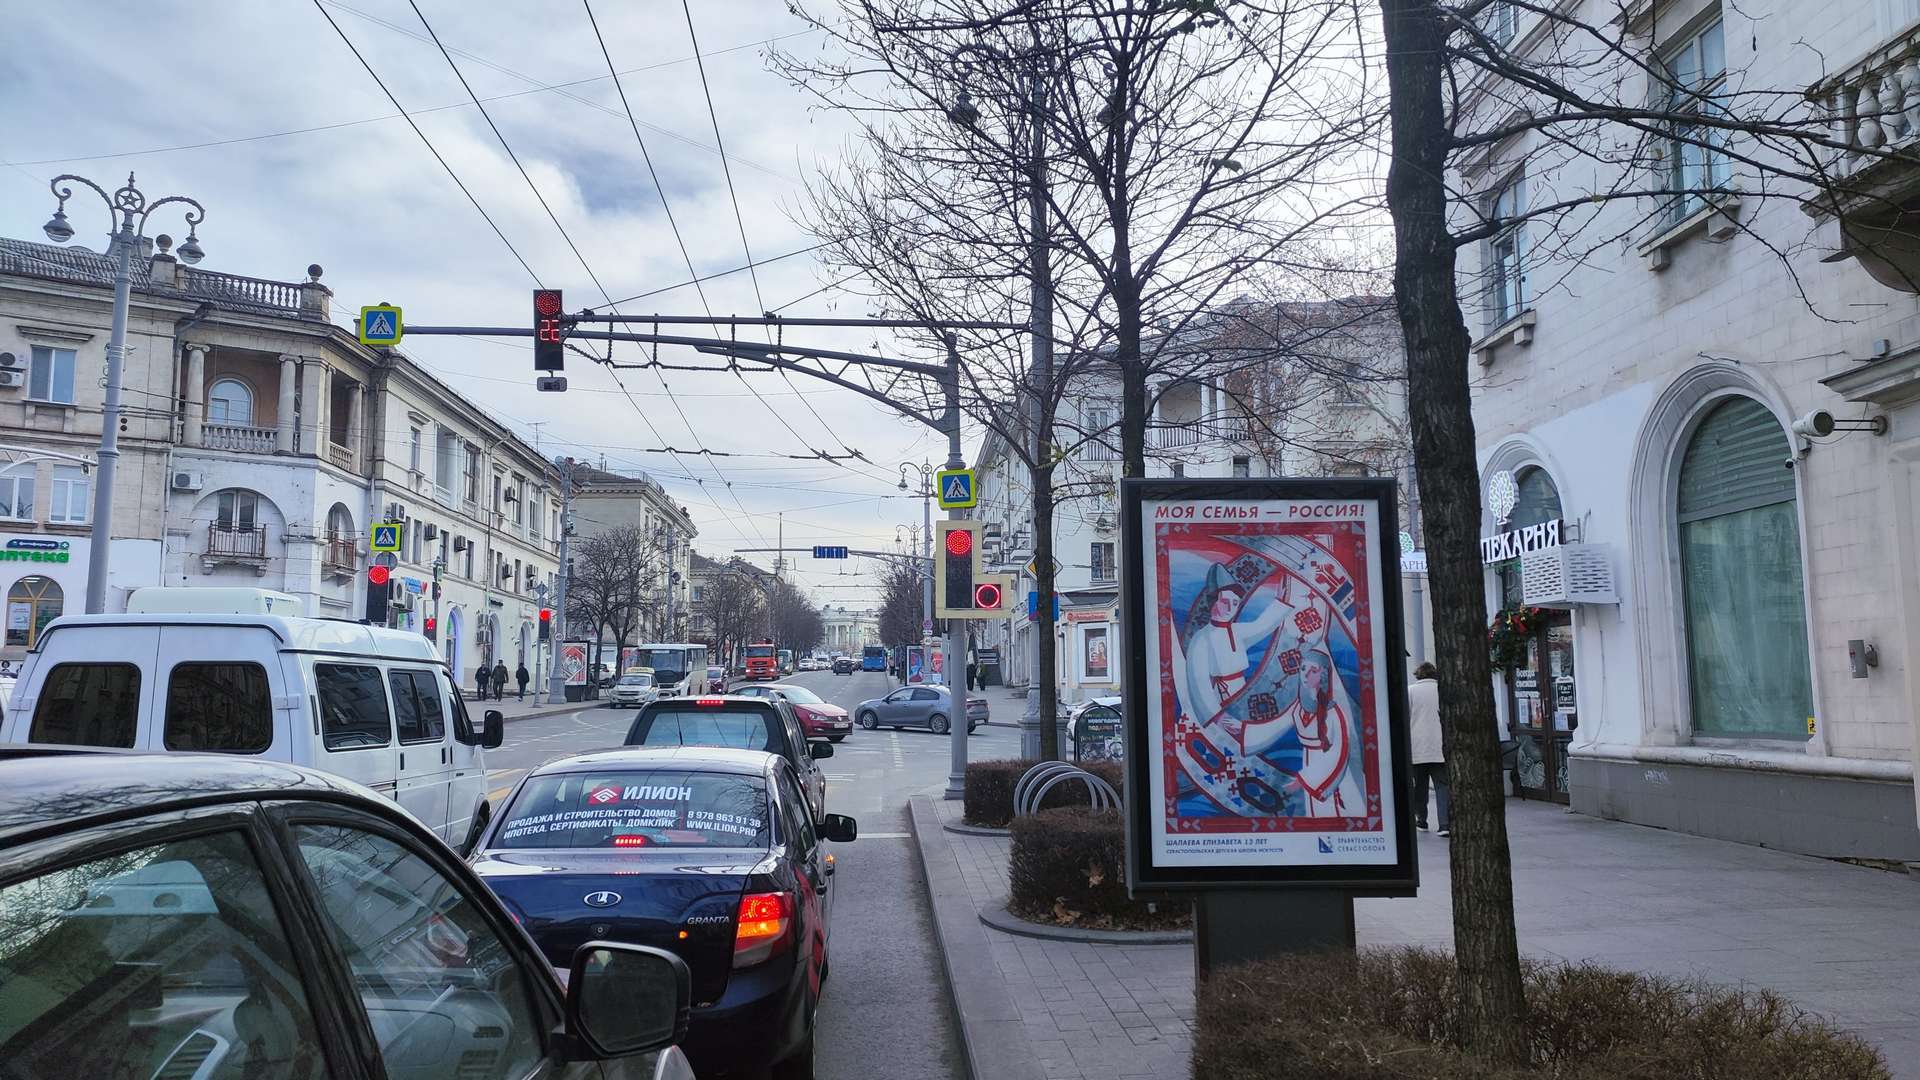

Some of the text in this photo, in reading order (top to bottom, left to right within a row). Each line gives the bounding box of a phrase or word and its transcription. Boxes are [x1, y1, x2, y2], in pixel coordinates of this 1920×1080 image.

[1155, 506, 1195, 518] МОЯ
[1202, 506, 1258, 518] СЕМЬЯ
[1289, 505, 1365, 518] РОССИЯ!
[1480, 519, 1559, 564] ПЕКАРНЯ
[622, 785, 692, 800] ИЛИОН
[507, 809, 676, 830] ПРОДАЖА И СТРОИТЕЛЬСТВО ДОМОВ
[696, 811, 714, 820] 978
[716, 812, 733, 823] 963
[736, 815, 747, 825] 91
[749, 818, 761, 828] 38
[503, 818, 675, 839] ИПОТЕКА. СЕРТИФИКАТЫ. ДОМКЛИК
[687, 820, 757, 837] WWW.ILION.PRO
[687, 916, 730, 925] GRANTA
